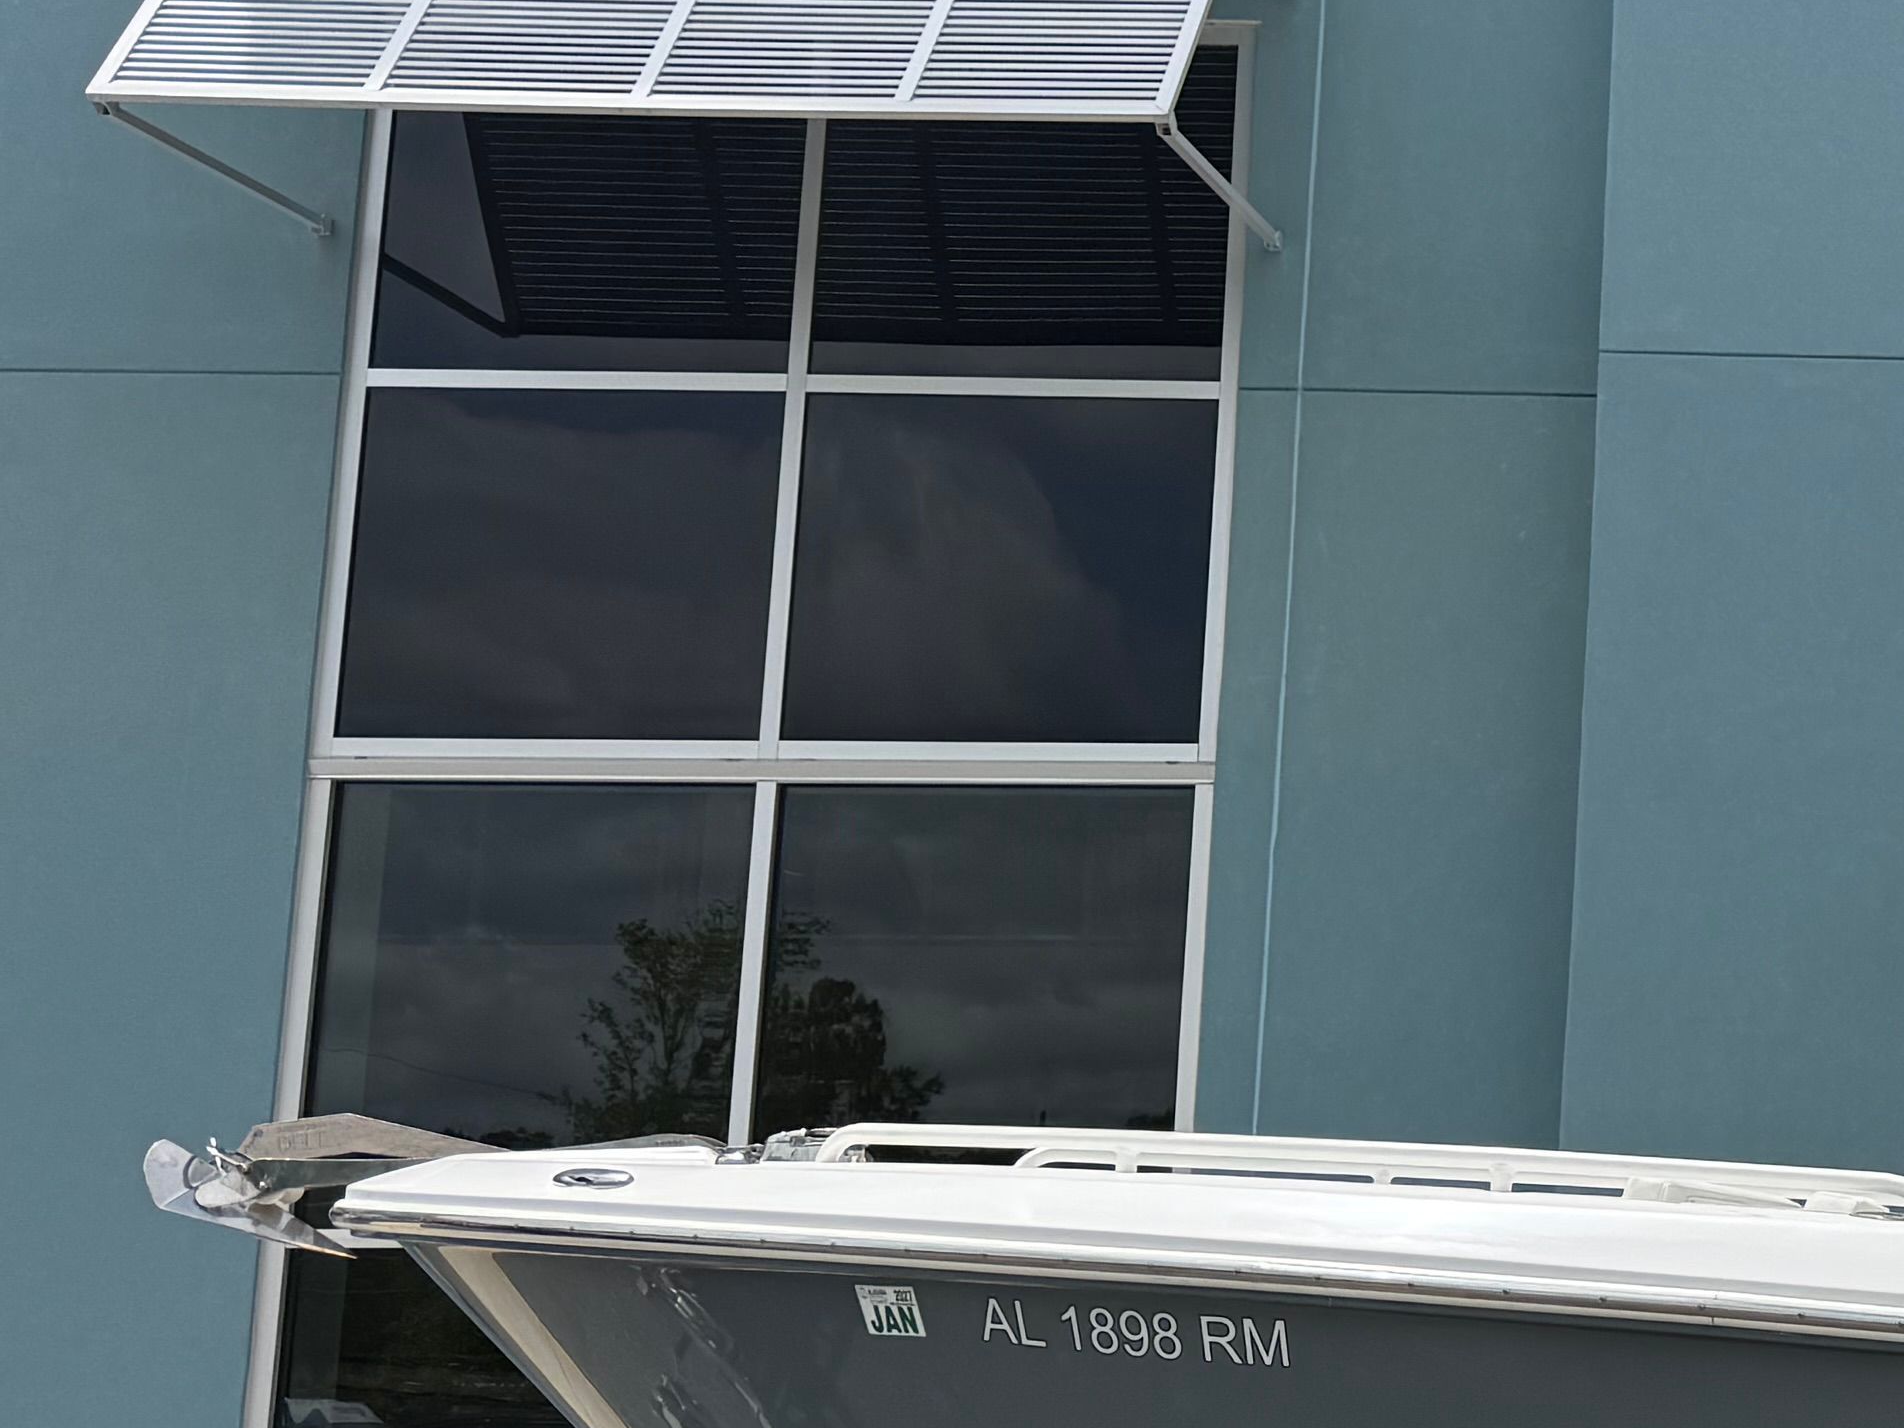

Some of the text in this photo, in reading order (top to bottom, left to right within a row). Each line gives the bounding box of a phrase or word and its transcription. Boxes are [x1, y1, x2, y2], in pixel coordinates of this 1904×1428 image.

[871, 1305, 920, 1334] JAN
[982, 1298, 1291, 1368] AL 1898 RM
